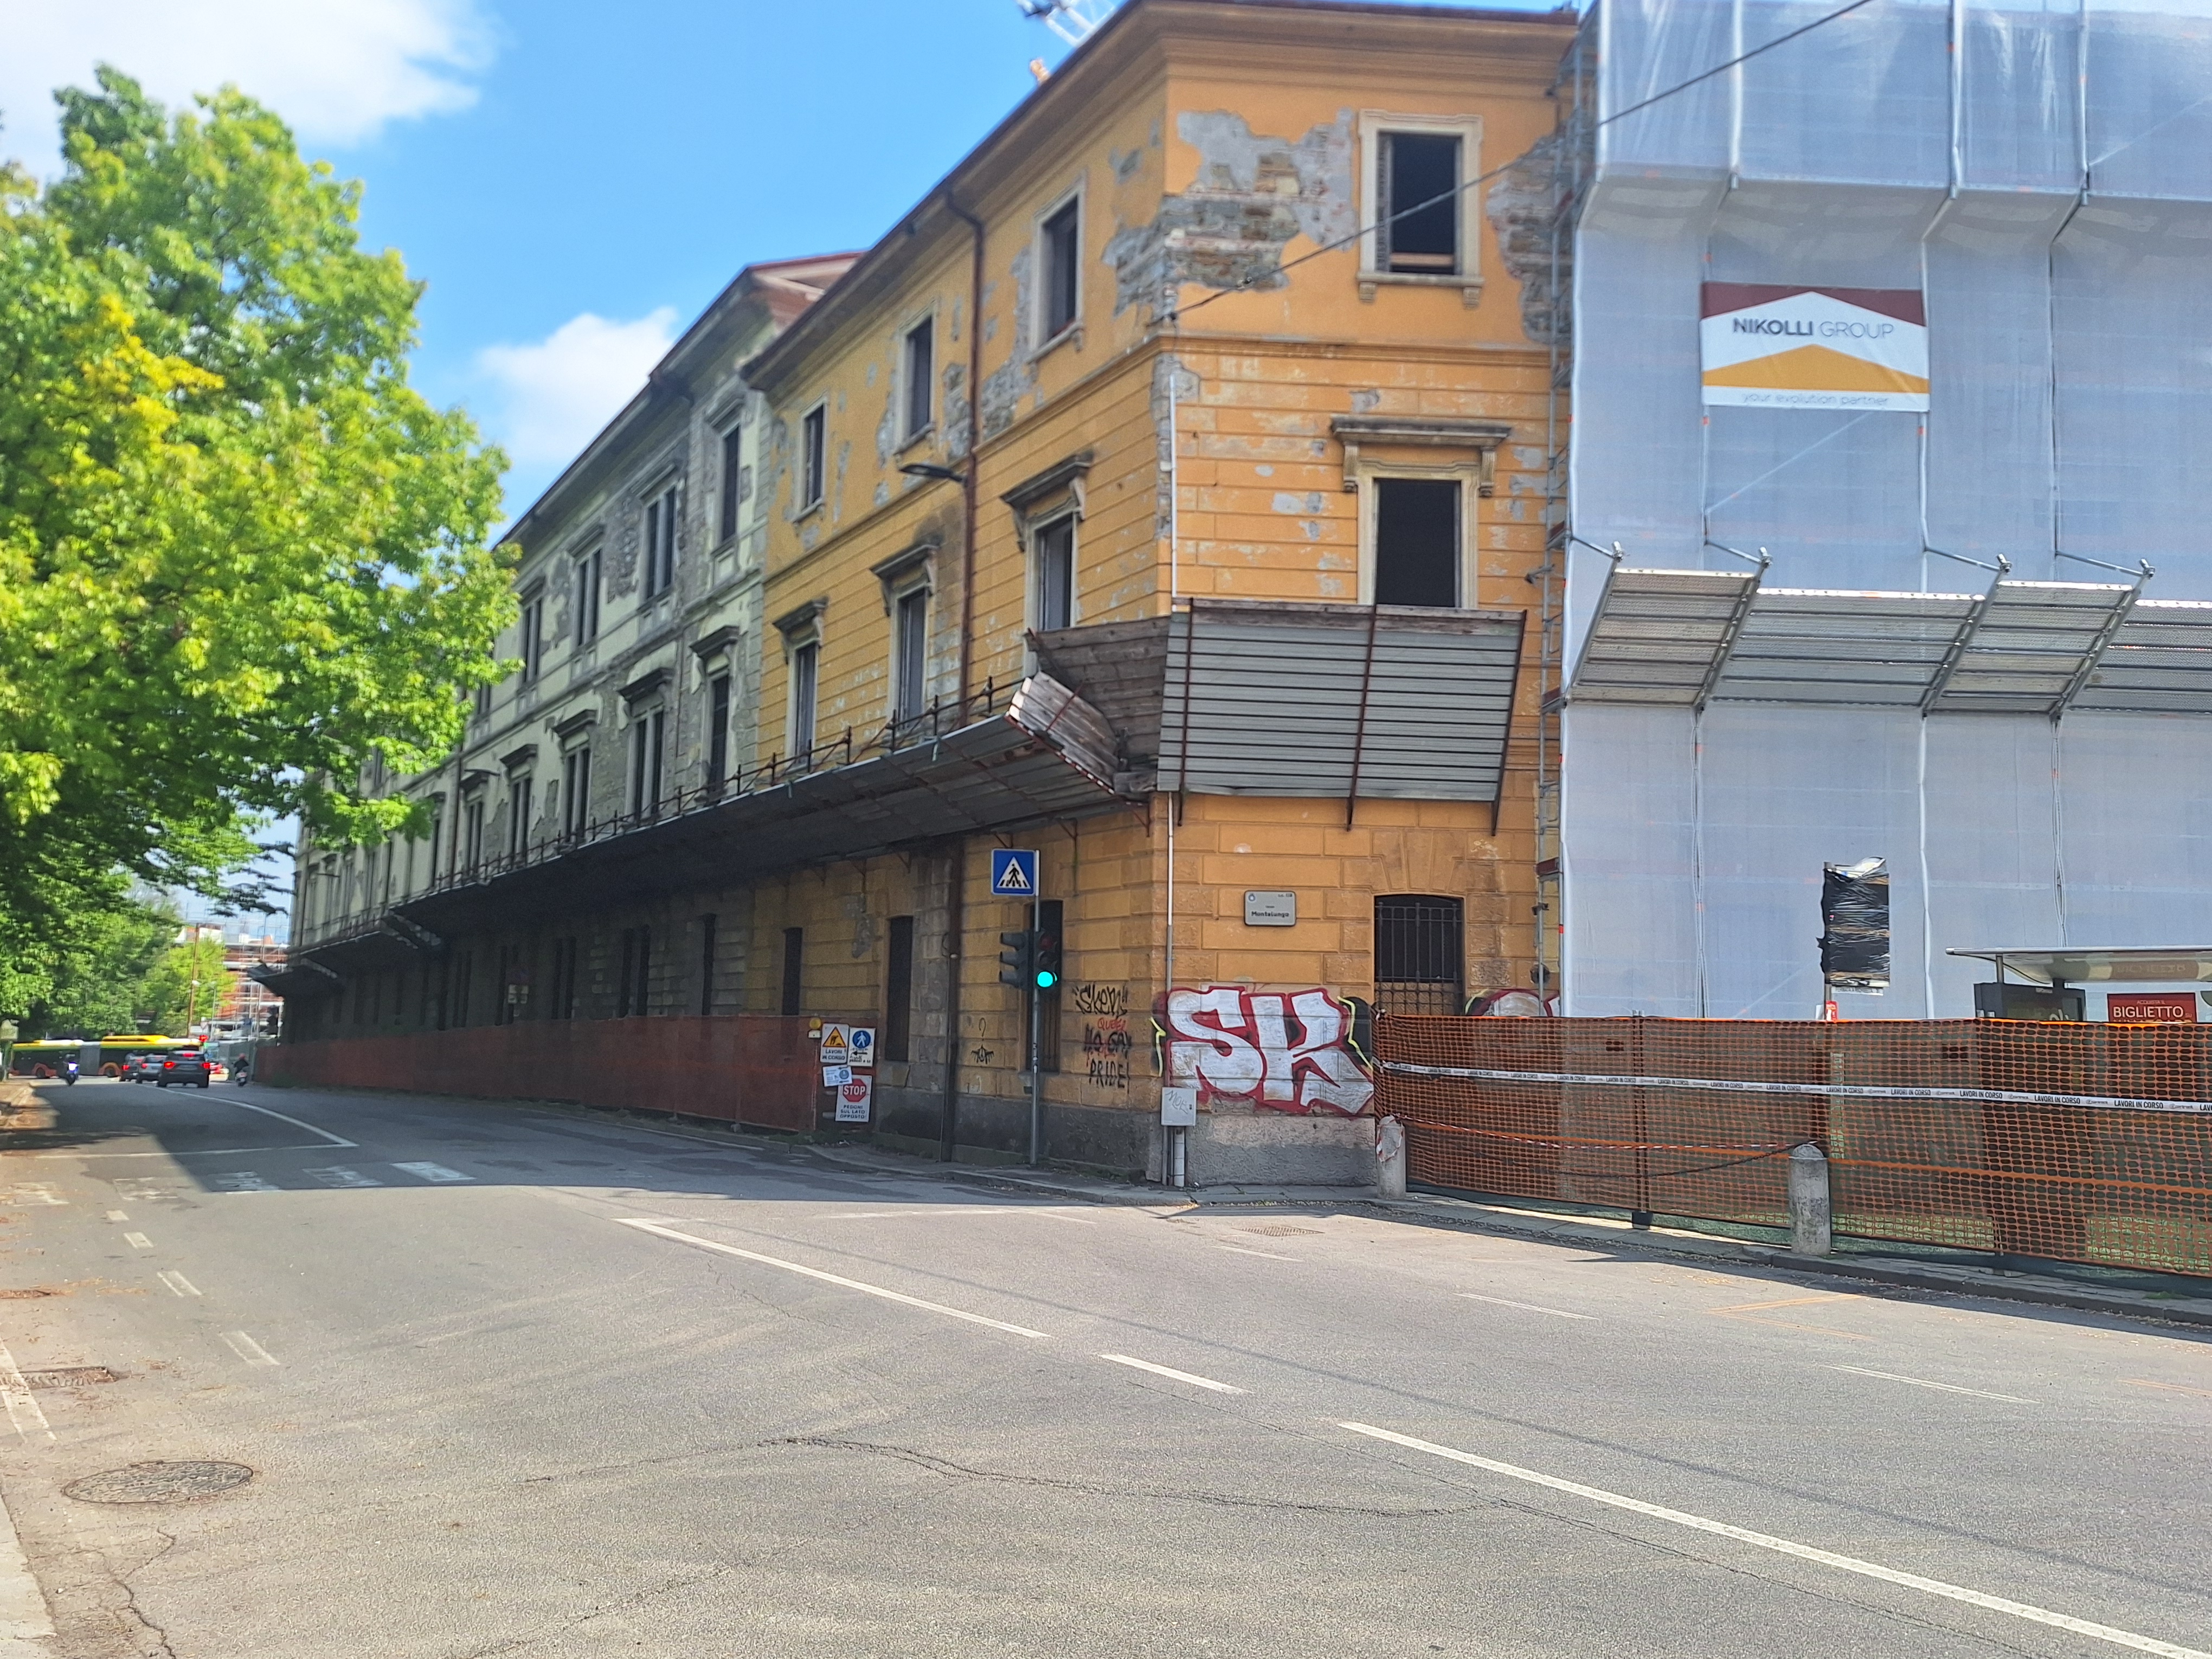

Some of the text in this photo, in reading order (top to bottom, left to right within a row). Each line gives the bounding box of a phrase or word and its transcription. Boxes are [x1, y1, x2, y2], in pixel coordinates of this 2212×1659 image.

[1733, 317, 1894, 339] NIKOLLI GROUP
[1742, 393, 1888, 406] your evolution partner
[2113, 1006, 2184, 1018] BIGLIETTO
[844, 1085, 865, 1095] STOP
